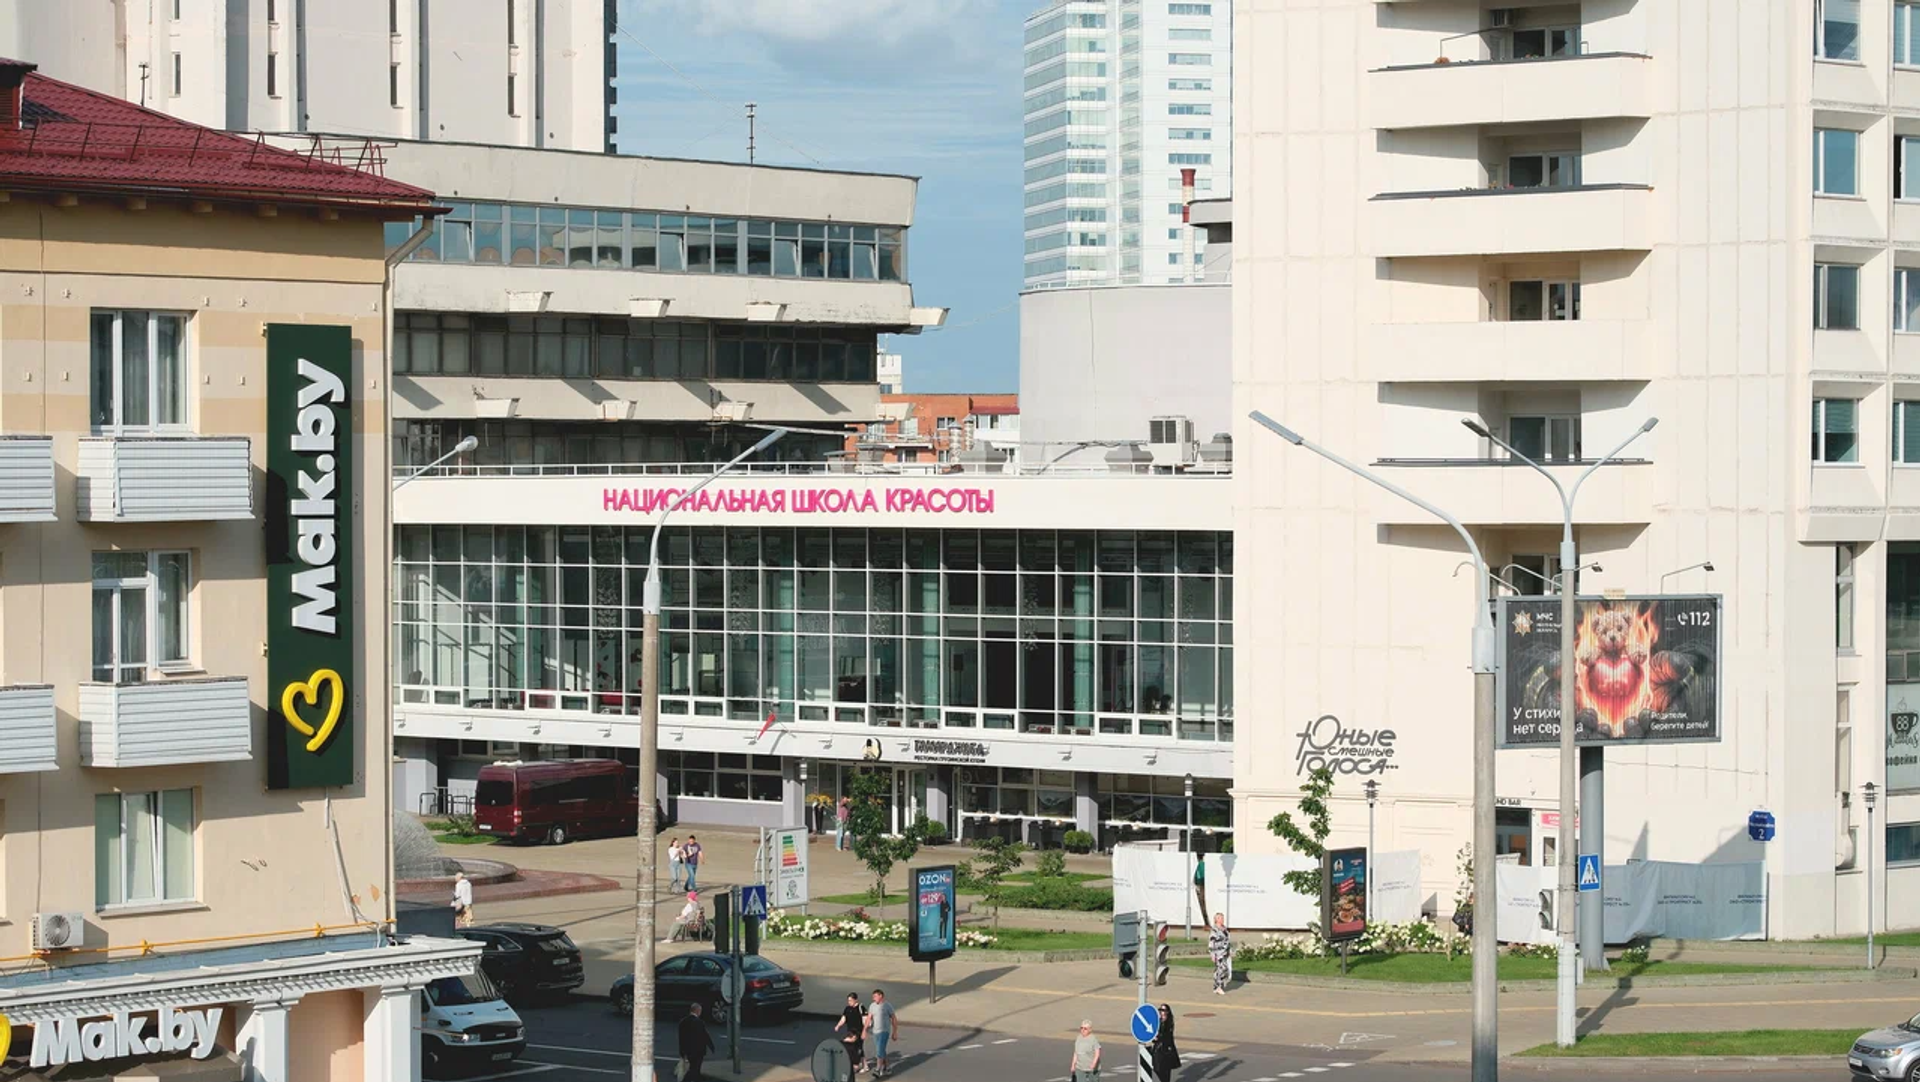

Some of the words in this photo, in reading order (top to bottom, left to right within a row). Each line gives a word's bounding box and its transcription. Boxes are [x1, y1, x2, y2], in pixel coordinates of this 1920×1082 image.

[291, 358, 345, 634] Mak.by
[603, 488, 786, 515] НАЦИОНАЛЬНАЯ
[791, 488, 879, 513] ШКОЛА
[885, 488, 994, 513] КРАСОТЫ
[1689, 611, 1710, 626] 112
[1513, 707, 1522, 720] У
[1525, 708, 1561, 719] стихи
[1513, 724, 1536, 735] нет
[1538, 722, 1584, 737] сера
[1296, 714, 1397, 761] Юные
[1327, 745, 1395, 757] смешные
[1758, 828, 1765, 840] 2
[919, 873, 946, 885] OZON
[30, 1008, 223, 1068] Mak.by
